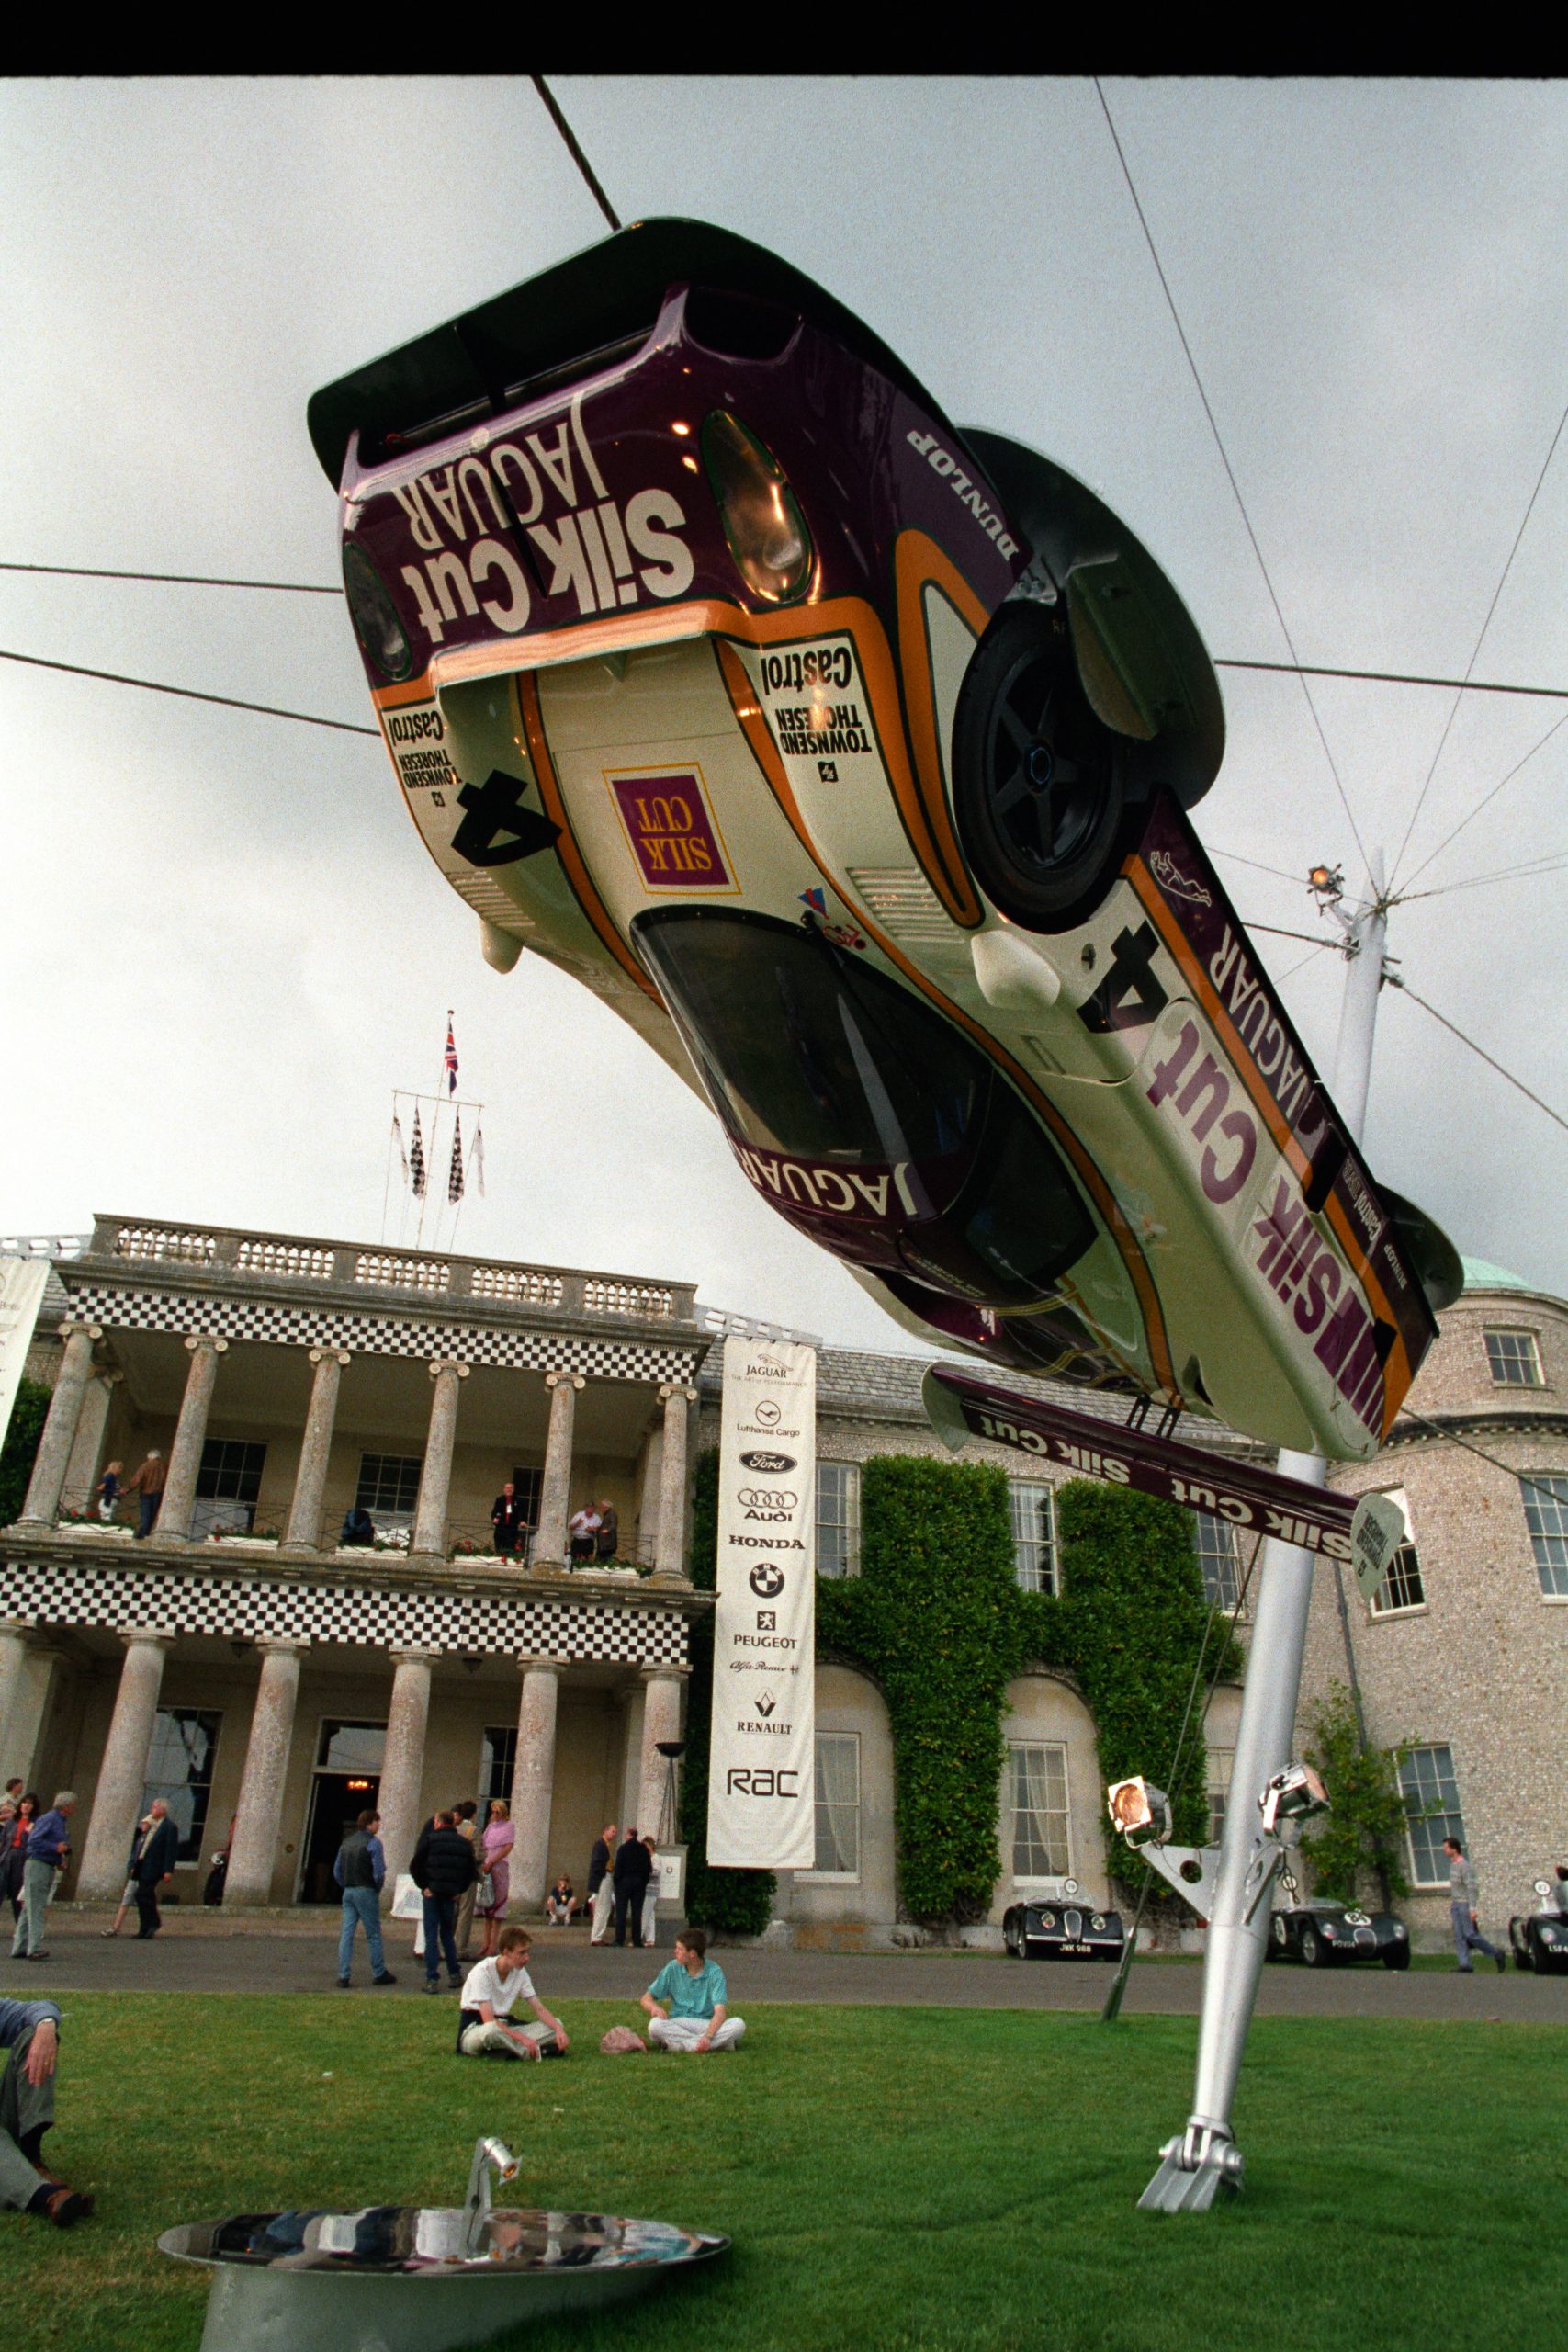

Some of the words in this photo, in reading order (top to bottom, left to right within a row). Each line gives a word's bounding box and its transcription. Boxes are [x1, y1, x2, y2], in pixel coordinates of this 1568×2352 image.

[391, 391, 610, 551] JAGUAR
[907, 430, 1020, 562] DUNLOP
[526, 488, 694, 616] Silk
[401, 538, 531, 643] Cut
[761, 647, 852, 695] Castrol
[388, 711, 443, 746] Castrol
[775, 705, 862, 731] THOESEN
[399, 749, 451, 771] THORESEN
[779, 729, 872, 755] TOWNSEND
[403, 766, 462, 788] TOWNSEND
[451, 769, 563, 867] 4
[636, 796, 693, 832] CUT
[639, 837, 712, 870] SILK
[1077, 920, 1169, 1034] 4
[1210, 922, 1309, 1122] JAGUAR
[1146, 1019, 1257, 1204] Cut
[734, 1145, 918, 1216] JAGUAR
[1353, 1193, 1382, 1242] Castrol
[1253, 1173, 1341, 1335] Silk
[746, 1365, 787, 1378] JAGUAR
[737, 1422, 774, 1436] Lufthansa
[775, 1428, 801, 1438] Cargo
[979, 1415, 1049, 1455] Cut
[750, 1453, 785, 1470] Ford
[1055, 1440, 1131, 1484] Silk
[1171, 1478, 1254, 1524] Cut
[728, 1534, 806, 1550] HONDA
[1264, 1510, 1353, 1560] Silk
[733, 1634, 797, 1649] PEUGEOT
[729, 1660, 752, 1673] Alfa
[755, 1661, 786, 1672] Romeo
[737, 1721, 793, 1735] RENAULT
